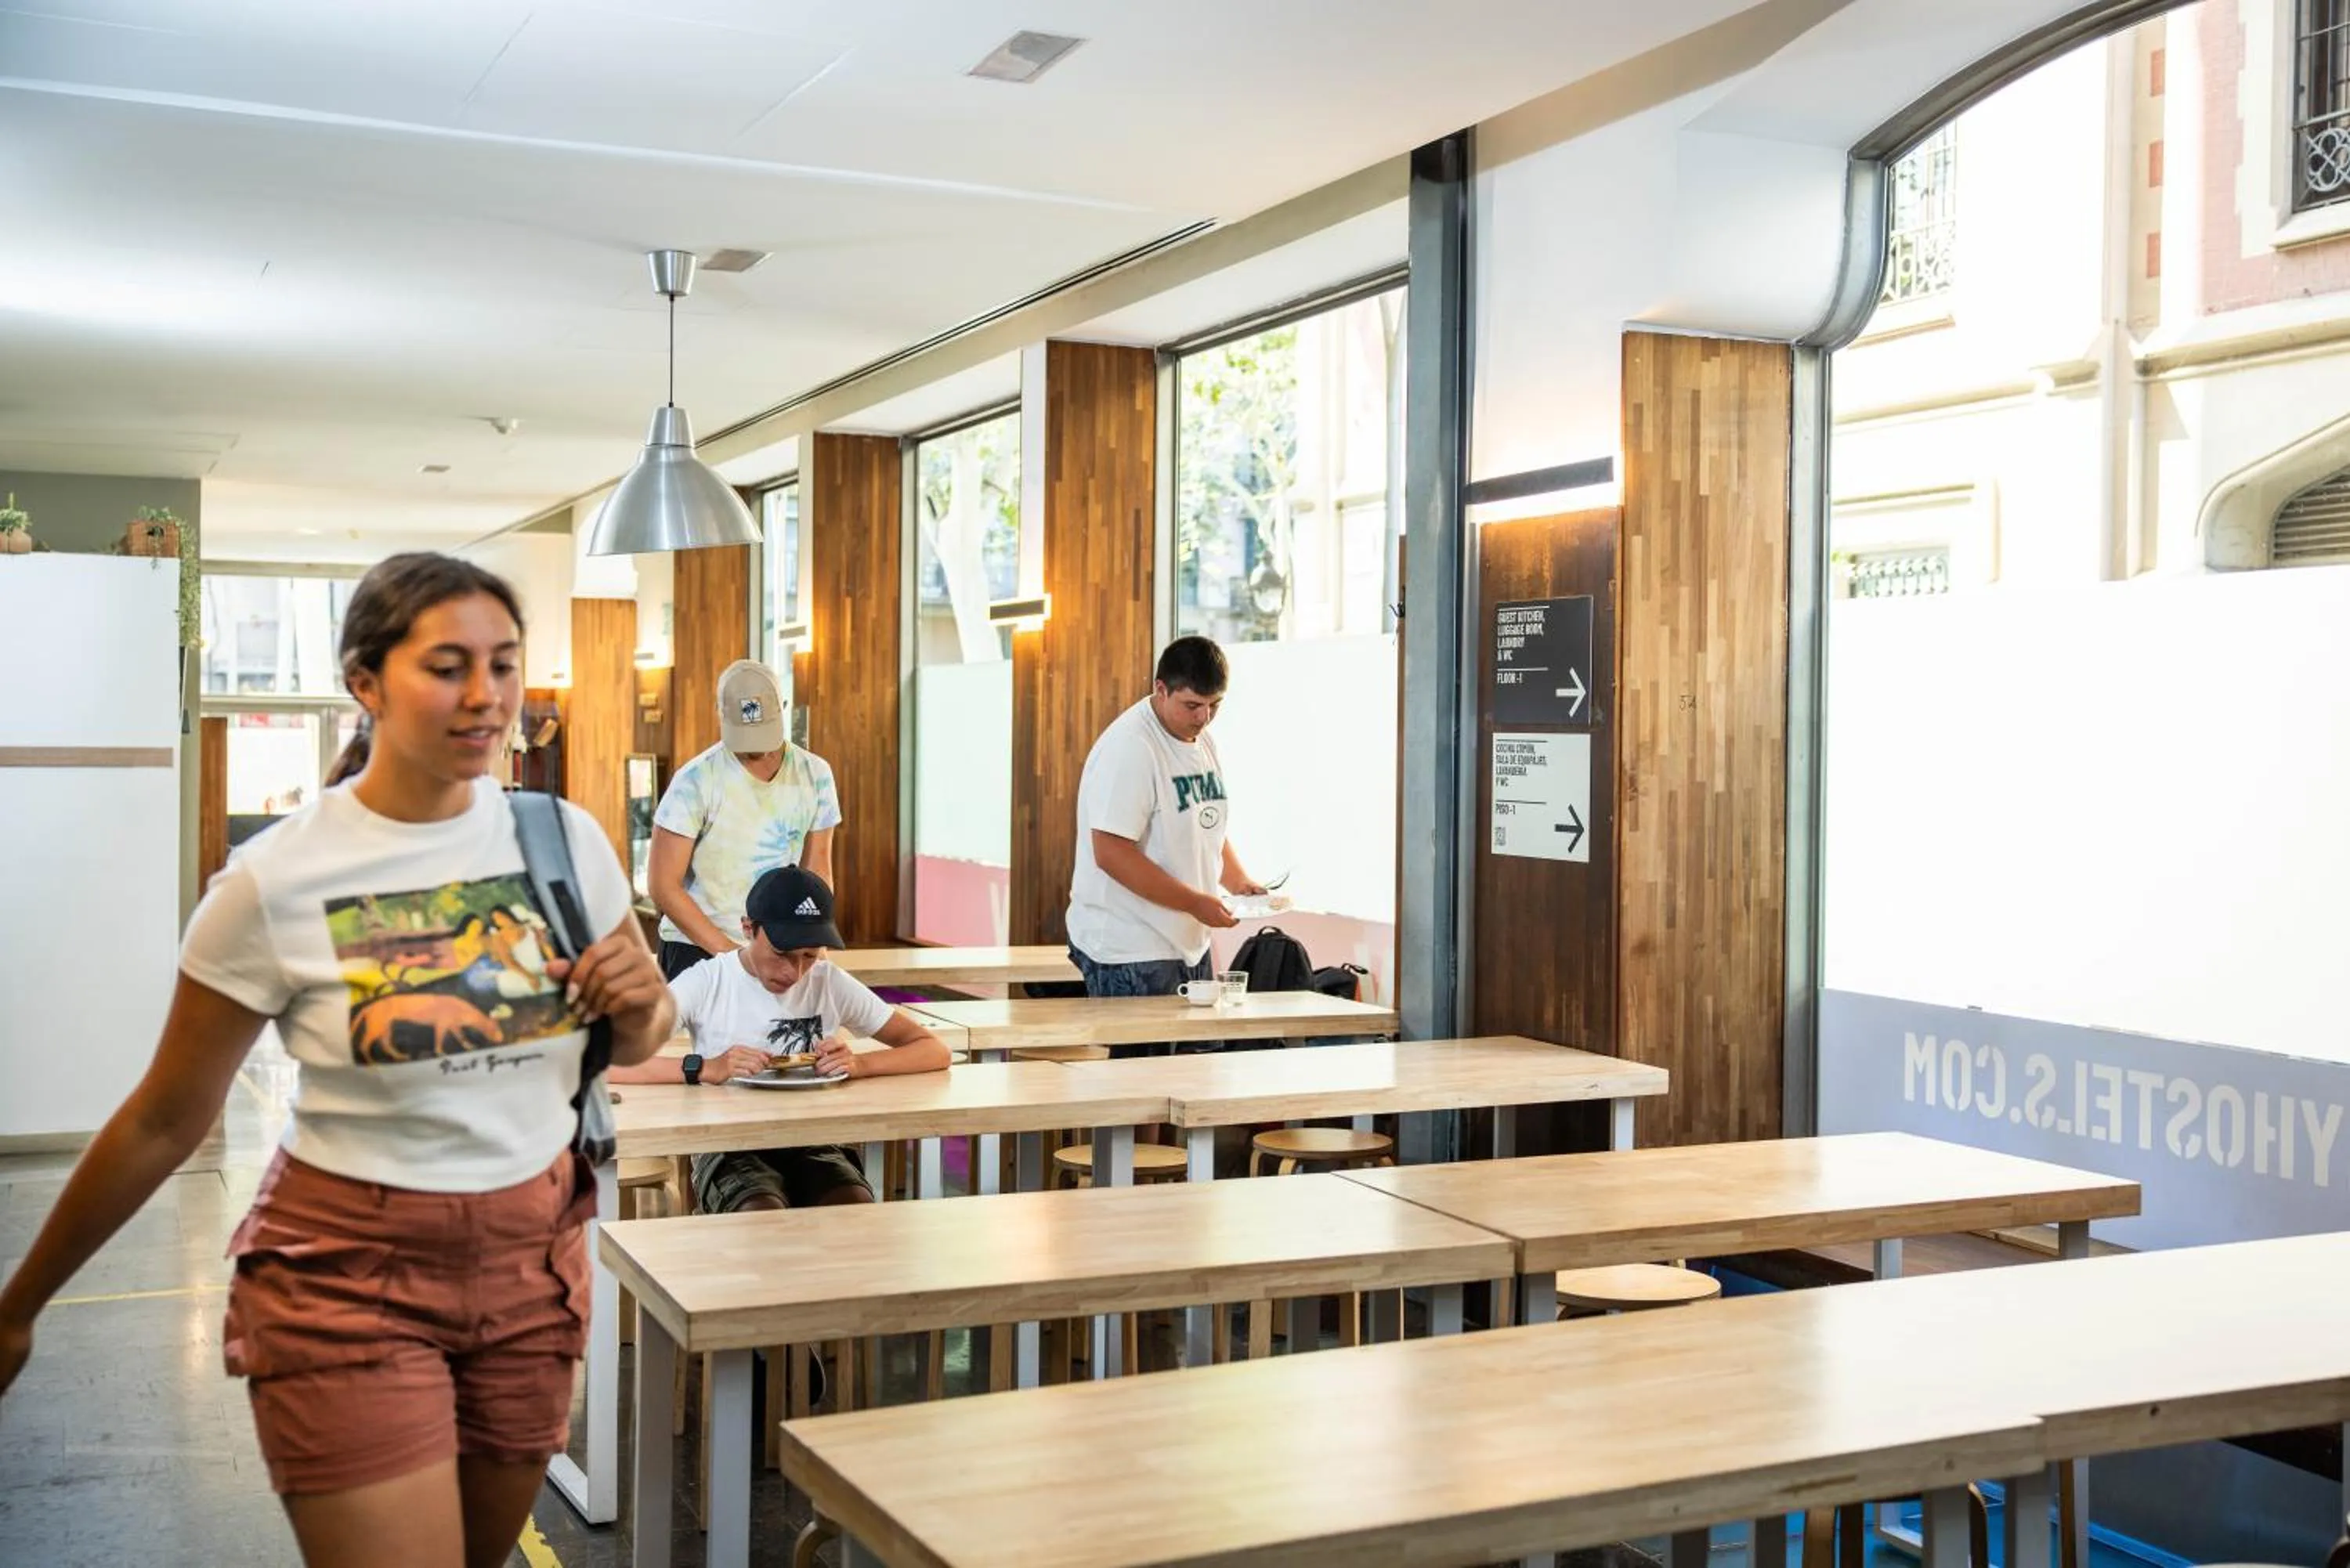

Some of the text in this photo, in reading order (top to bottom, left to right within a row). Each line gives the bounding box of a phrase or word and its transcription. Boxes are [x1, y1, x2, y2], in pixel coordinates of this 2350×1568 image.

[1498, 612, 1517, 623] GUEST
[1498, 623, 1524, 636] LUGGAGE
[1498, 637, 1524, 649] LAUNDRY
[1503, 650, 1513, 661] WC
[1497, 673, 1516, 684] FLOOR
[1509, 755, 1517, 764] DE
